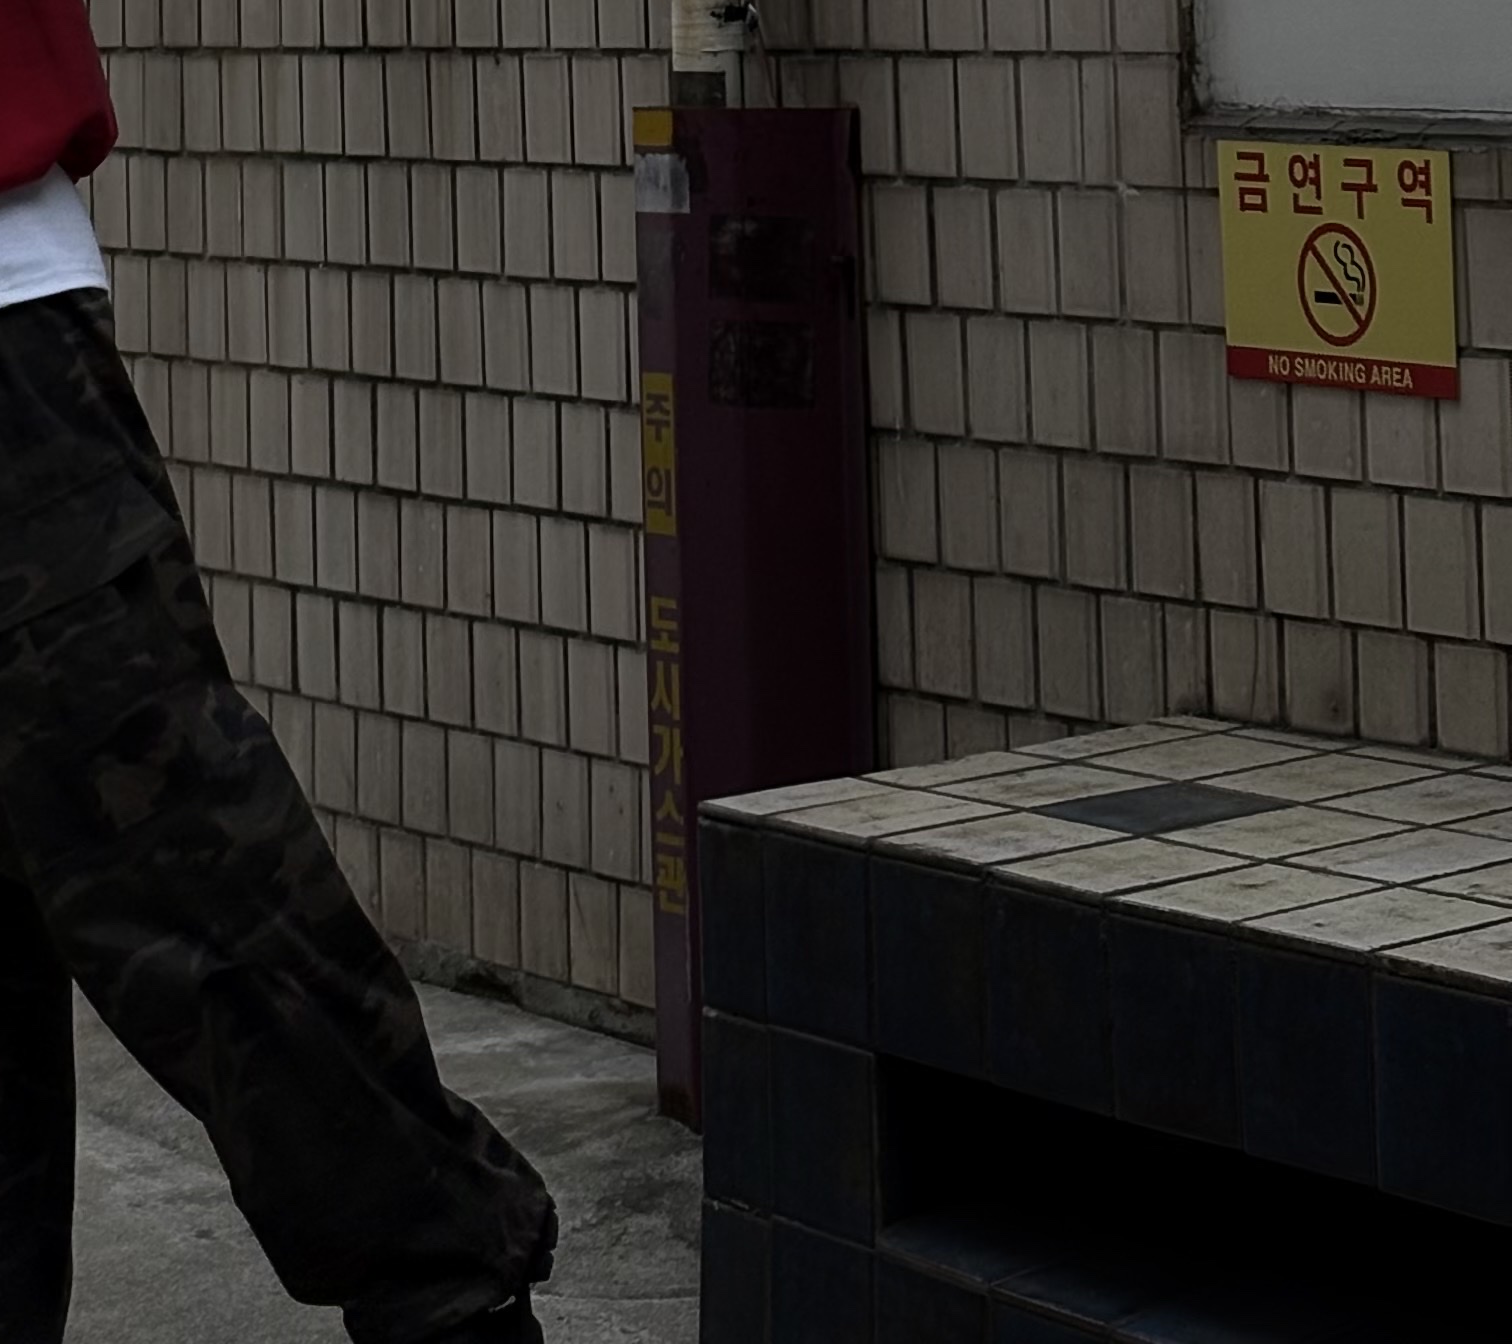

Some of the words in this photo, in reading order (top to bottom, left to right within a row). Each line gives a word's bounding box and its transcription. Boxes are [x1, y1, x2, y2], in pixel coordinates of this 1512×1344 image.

[1234, 151, 1433, 224] 금연구역
[1268, 354, 1290, 376] NO
[1293, 357, 1366, 384] SMOKING
[1370, 364, 1413, 389] AREA
[645, 393, 672, 516] 주의
[650, 595, 686, 915] 도시가스관
